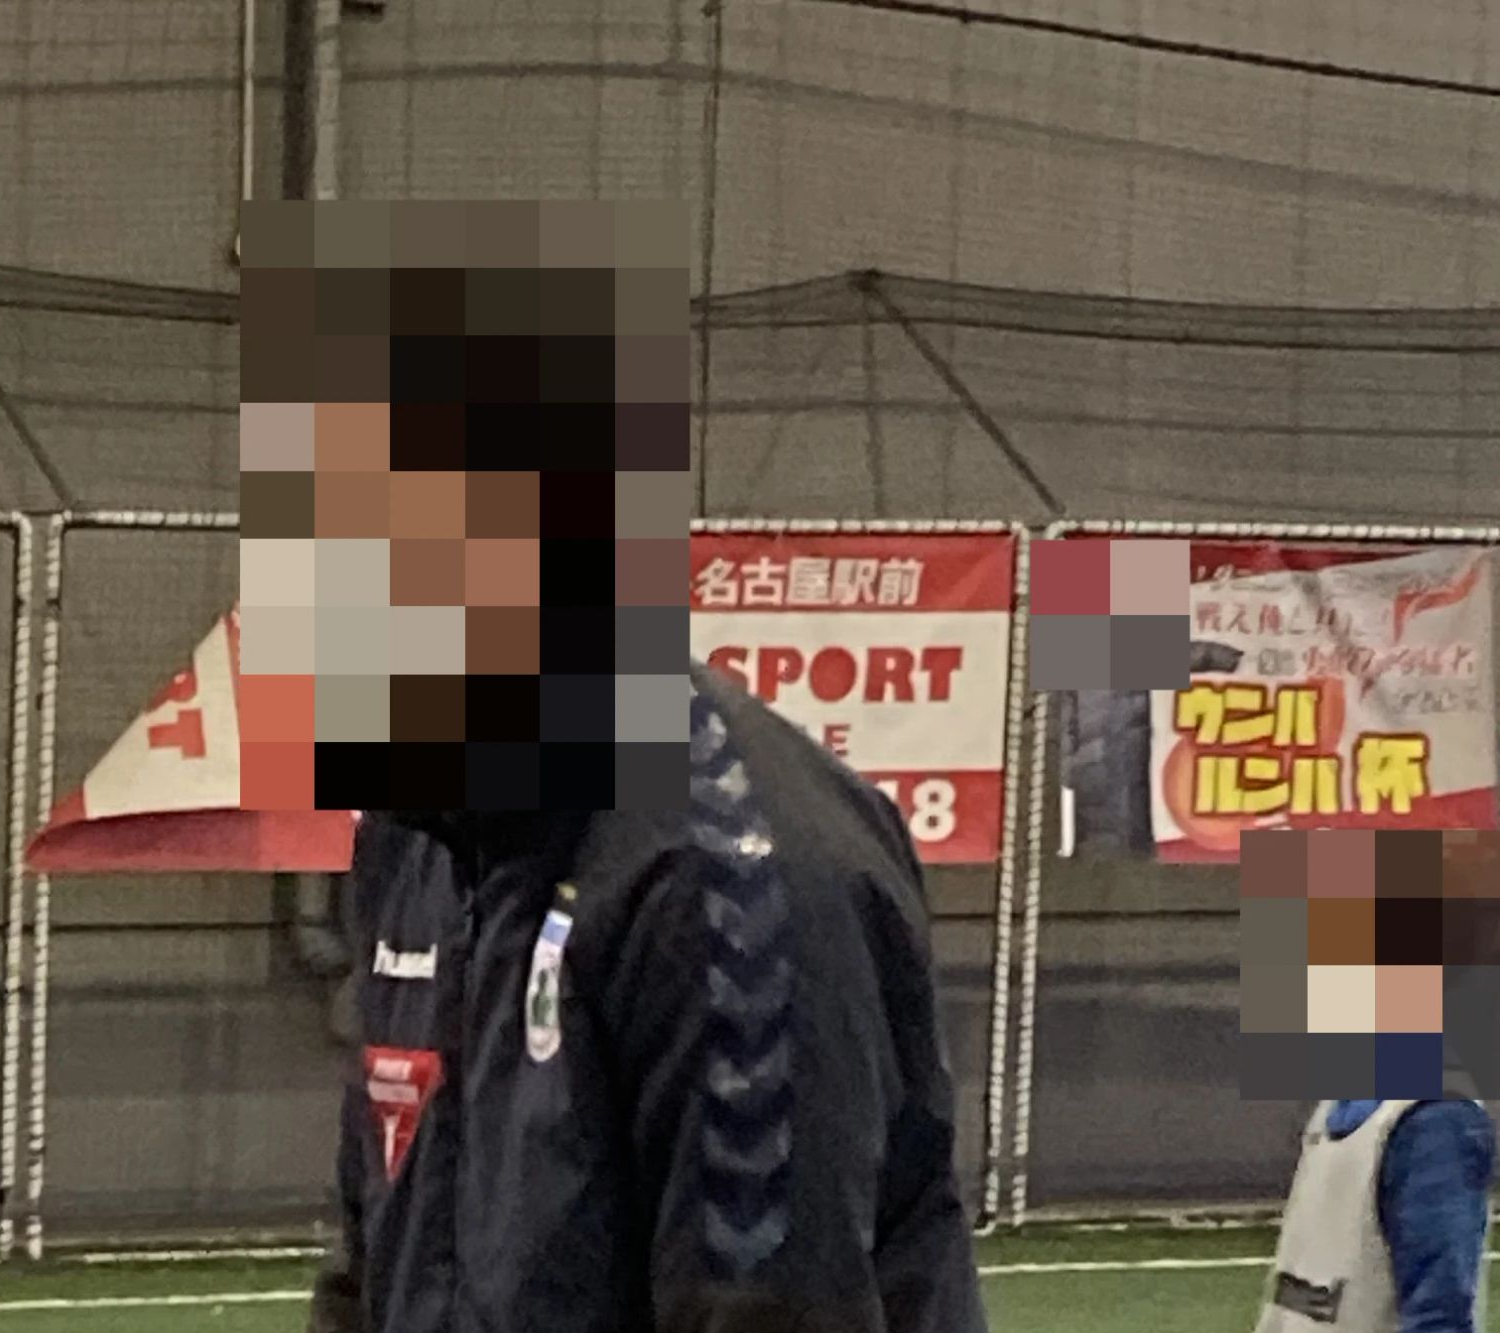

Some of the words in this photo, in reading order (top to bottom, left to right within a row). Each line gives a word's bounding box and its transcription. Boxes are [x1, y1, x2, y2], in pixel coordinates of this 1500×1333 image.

[695, 556, 924, 606] 名古屋駅前
[707, 646, 963, 703] SPORT
[1356, 735, 1426, 815] 杯
